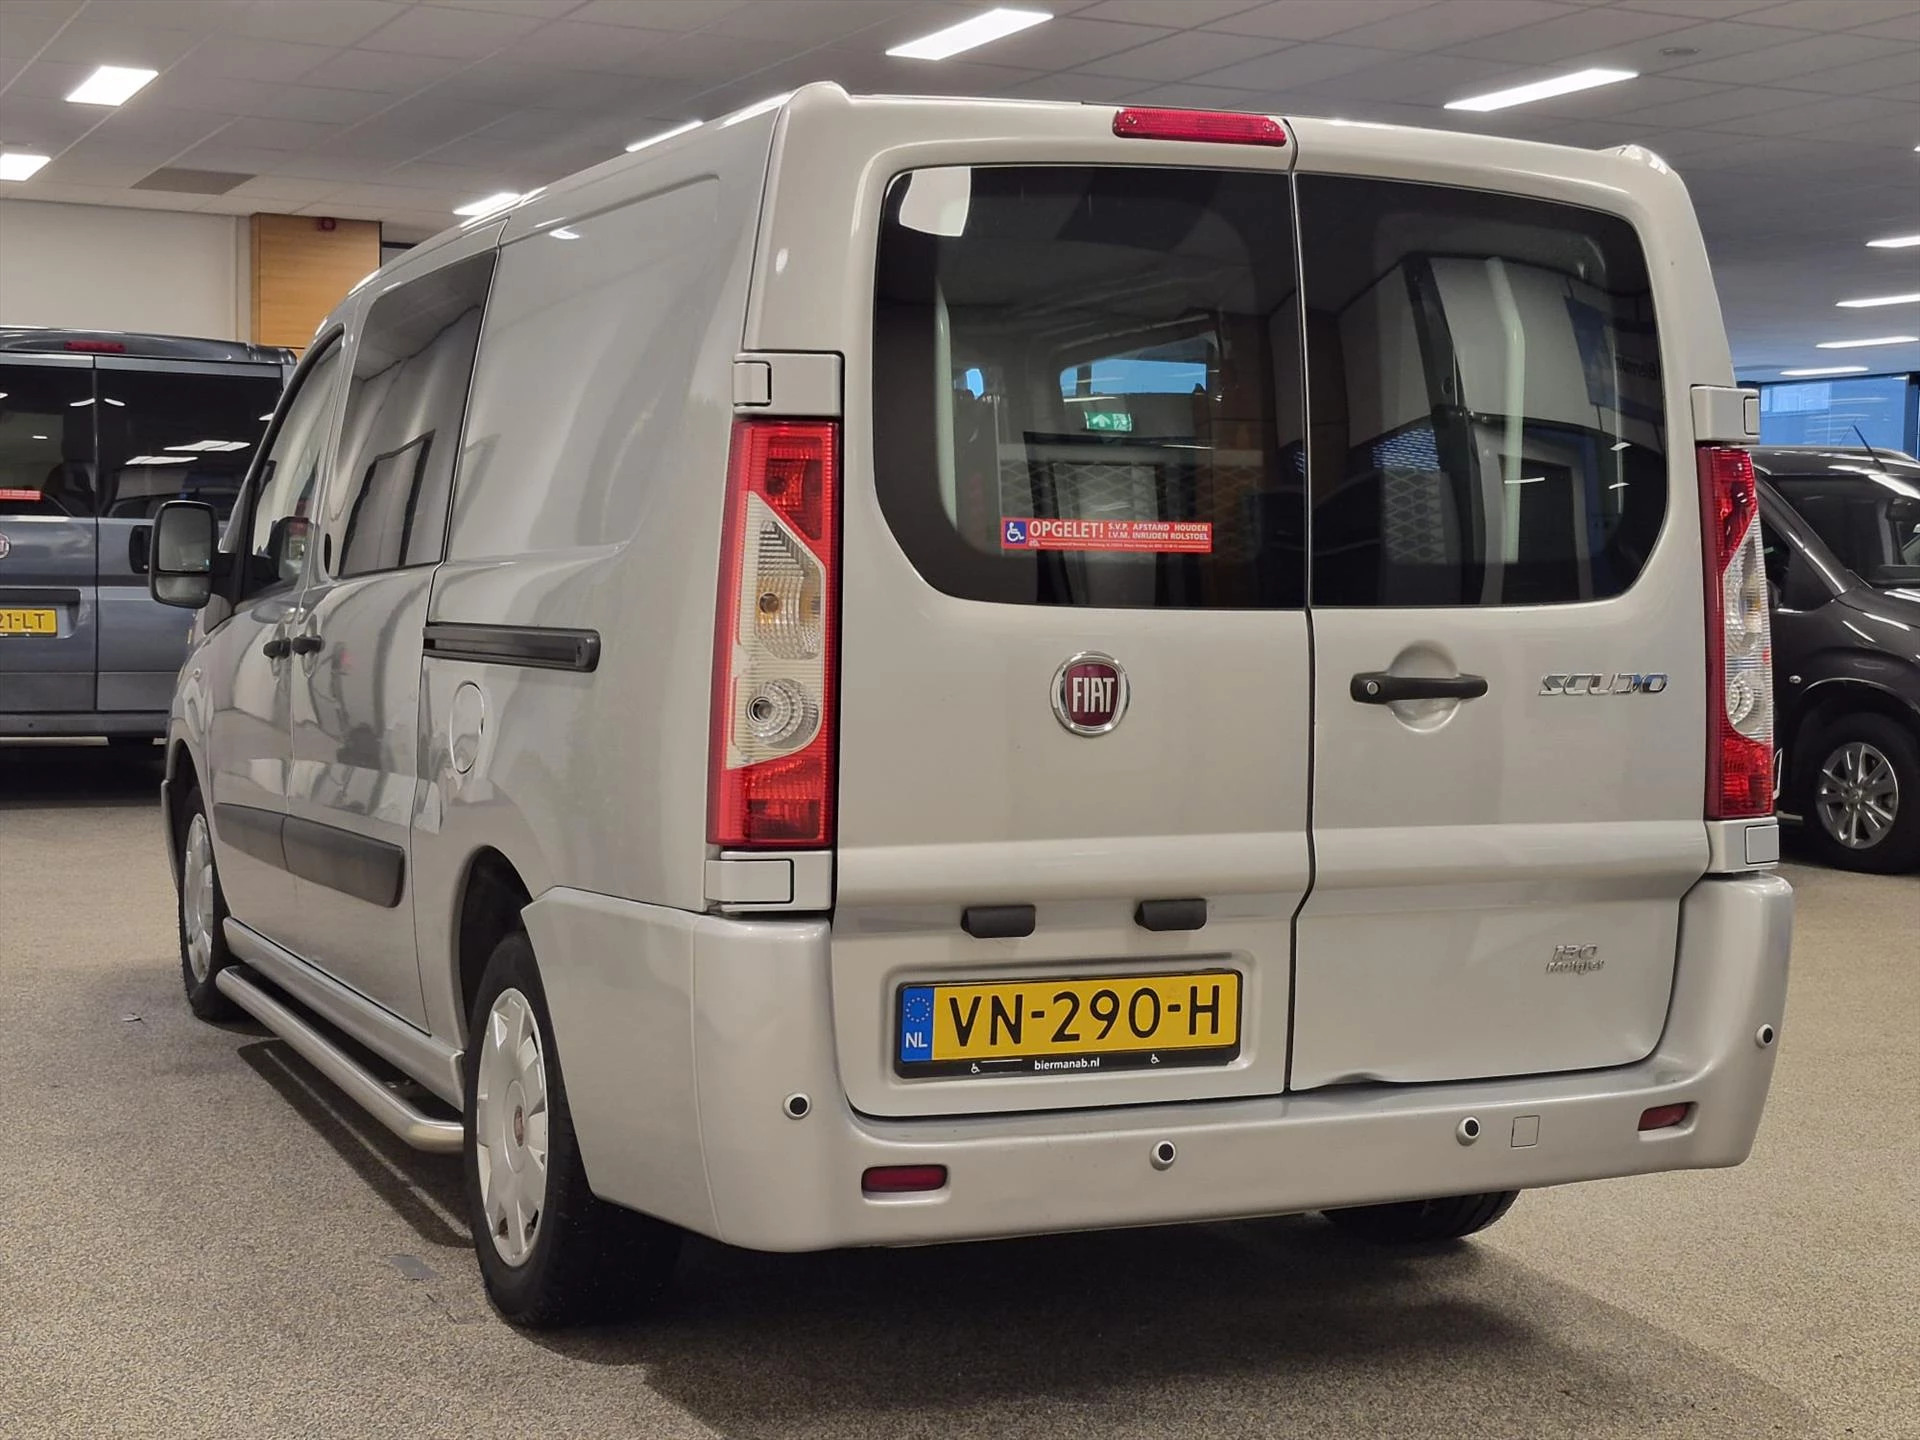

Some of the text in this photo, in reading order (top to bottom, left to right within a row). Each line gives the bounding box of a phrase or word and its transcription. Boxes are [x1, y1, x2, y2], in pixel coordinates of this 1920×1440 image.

[1029, 520, 1104, 538] OPGELET!
[1108, 522, 1208, 532] S.V.P. AFSTAND HOUDEN
[1108, 531, 1130, 539] I.V.M.
[1170, 532, 1209, 540] ROLSTOEL
[1538, 672, 1668, 696] SCUDO
[1072, 677, 1115, 713] FIAT
[1552, 943, 1598, 960] 130
[949, 985, 1220, 1047] VN-290-H
[905, 1032, 928, 1049] NL
[1034, 1057, 1100, 1070] biermanab.nl
